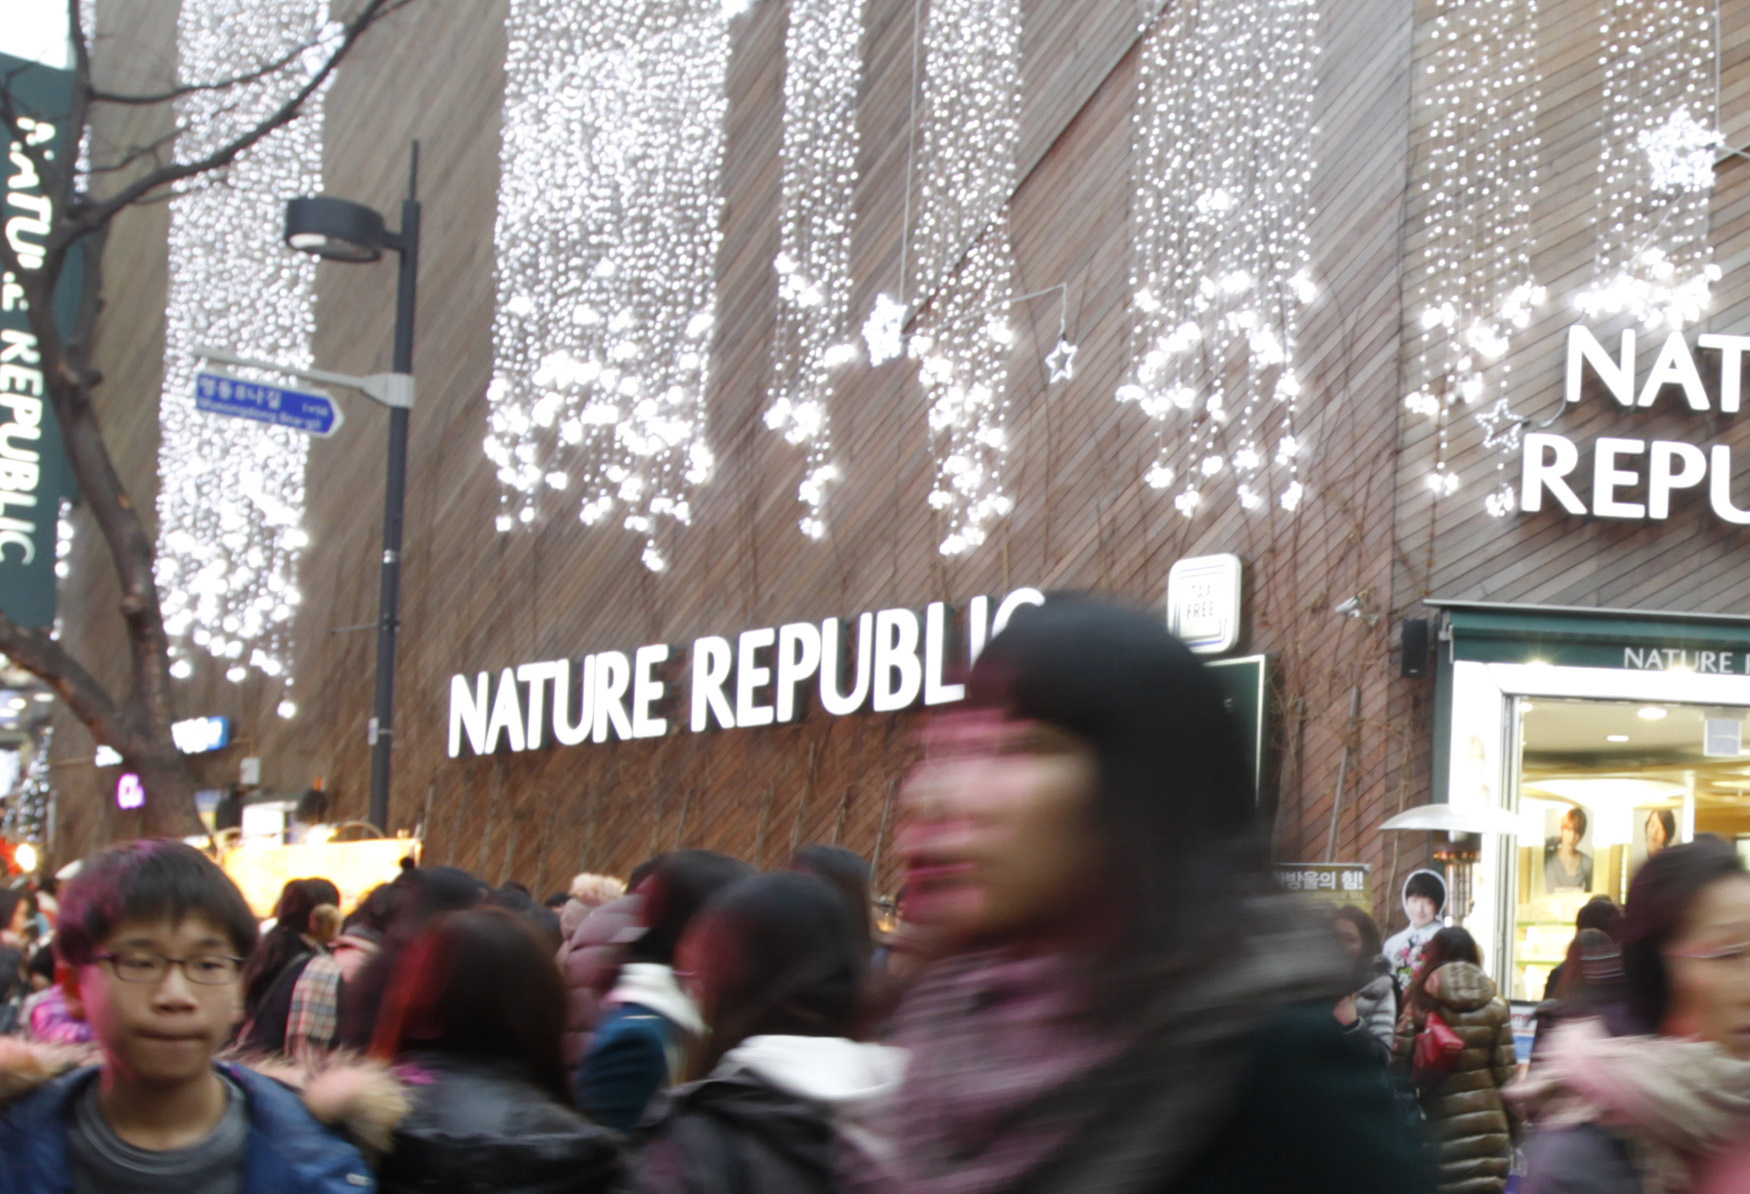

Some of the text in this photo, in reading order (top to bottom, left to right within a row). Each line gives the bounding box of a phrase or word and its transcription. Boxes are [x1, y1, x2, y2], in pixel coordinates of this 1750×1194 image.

[1186, 600, 1214, 620] FREE
[1622, 647, 1735, 674] NATURE
[448, 643, 669, 759] NATURE
